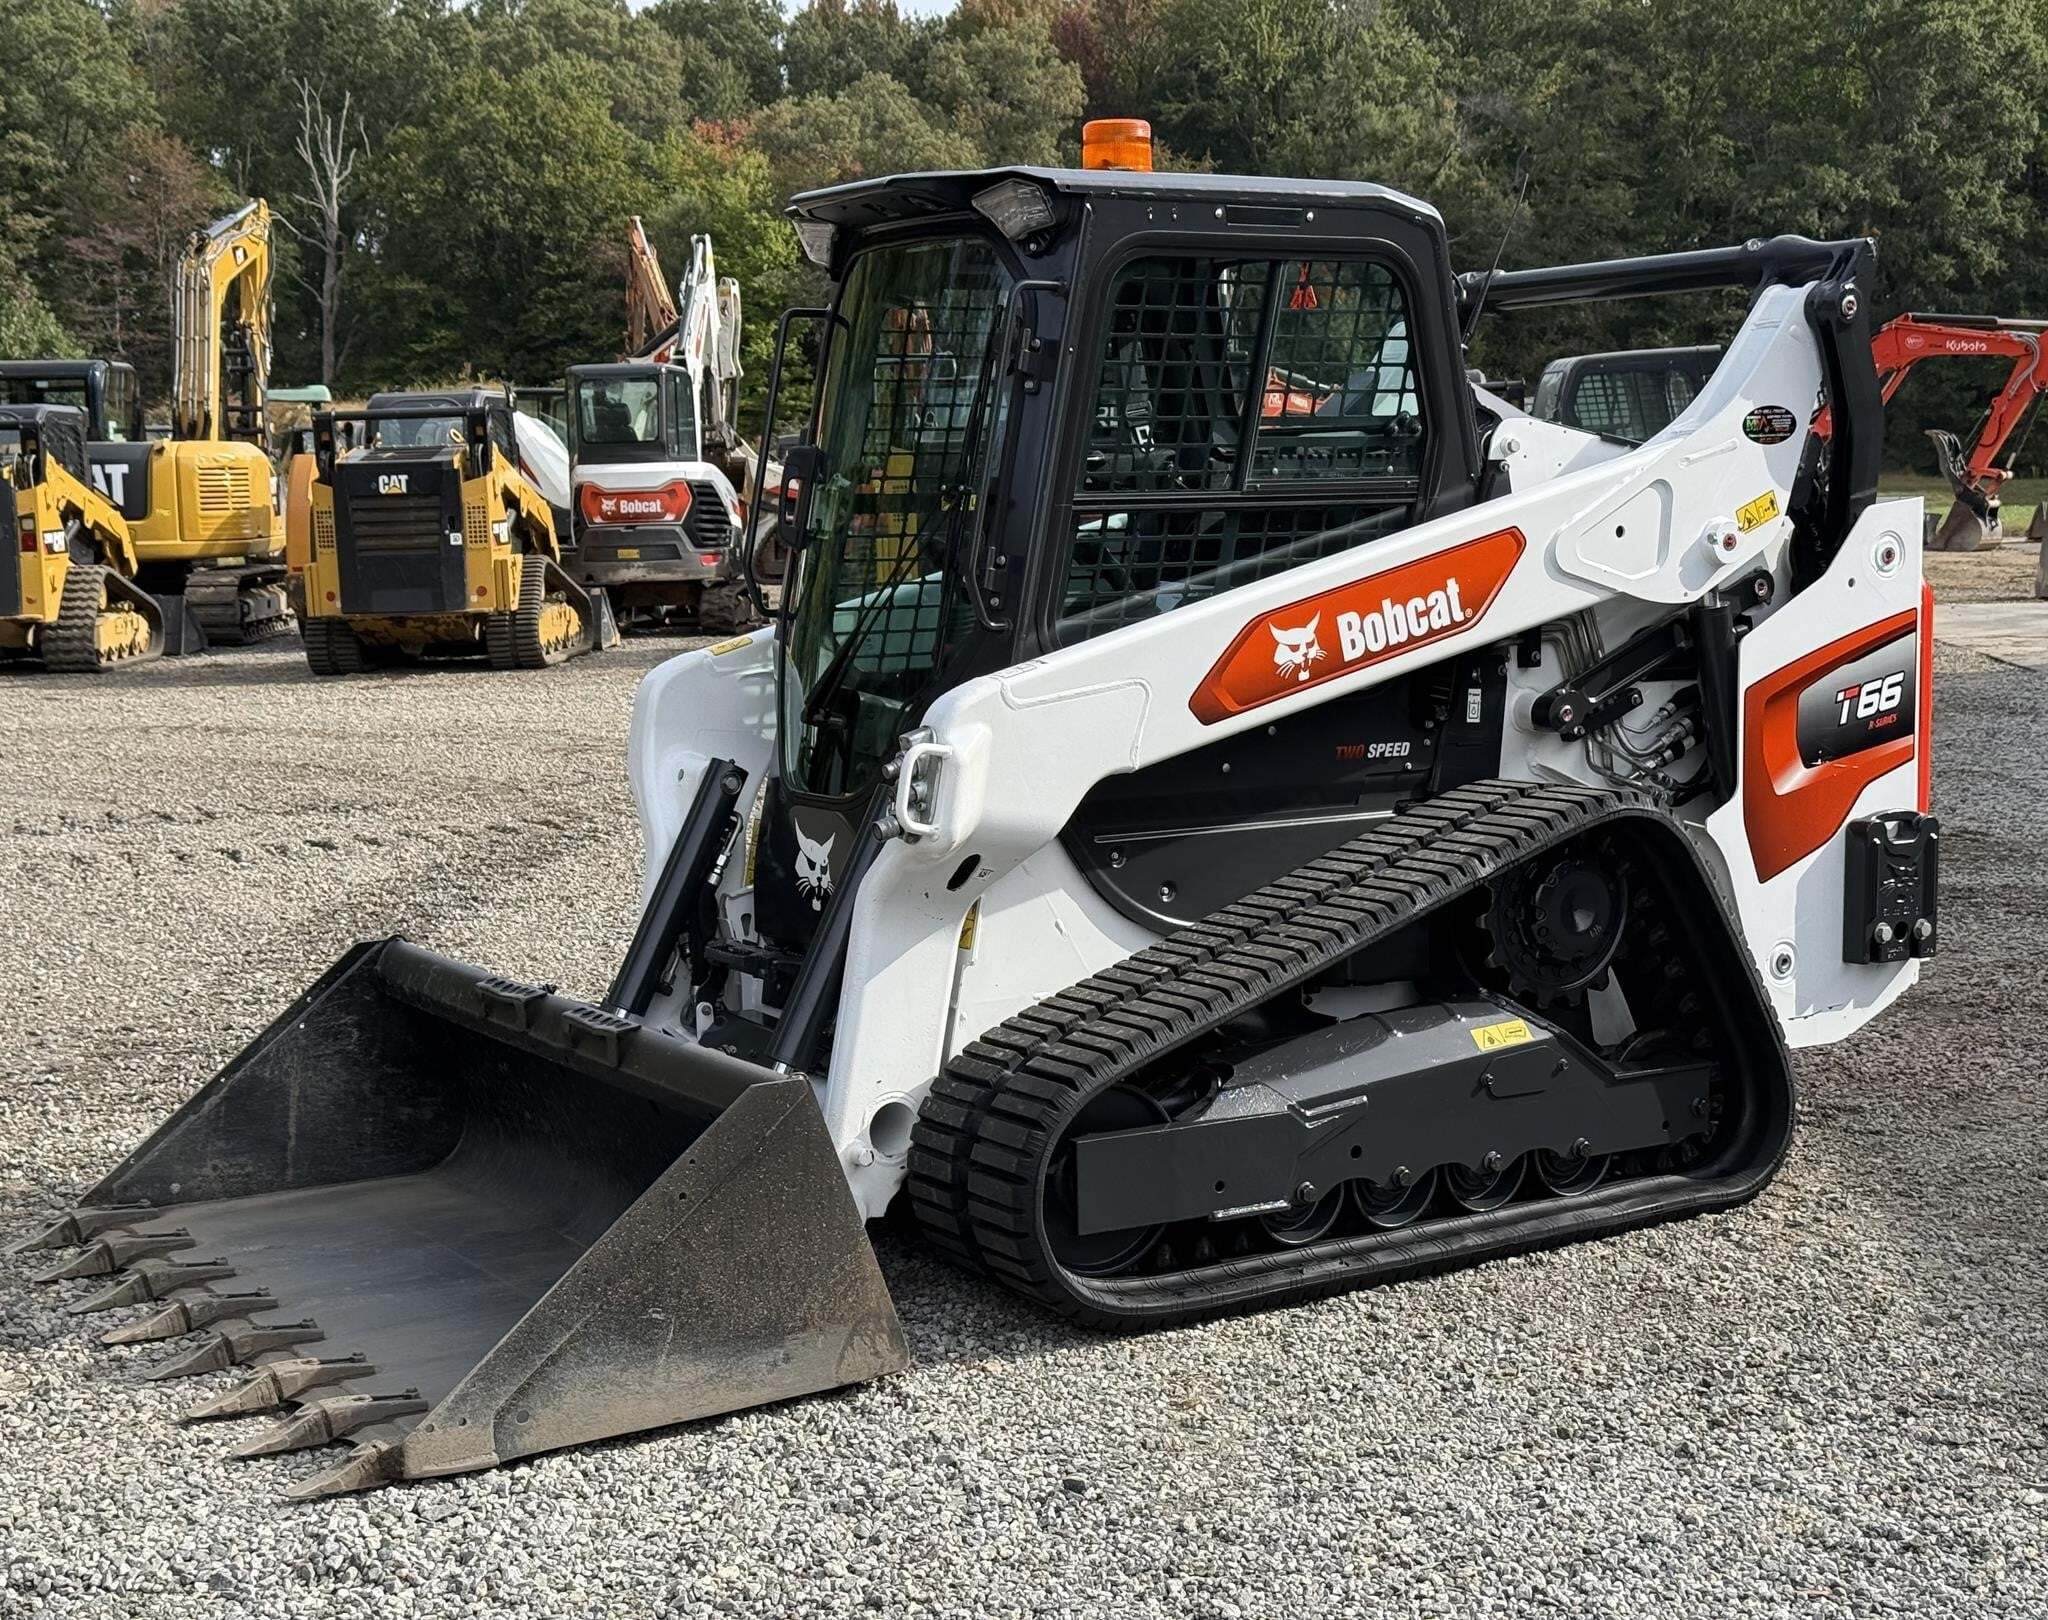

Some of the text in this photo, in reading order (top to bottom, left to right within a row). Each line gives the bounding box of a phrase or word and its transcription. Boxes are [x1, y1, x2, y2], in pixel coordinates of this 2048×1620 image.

[1946, 340, 1987, 352] Kubota
[378, 474, 409, 494] CAT
[620, 499, 663, 513] Bobcat
[1836, 671, 1905, 725] T66
[1336, 741, 1411, 760] TWO SPEED
